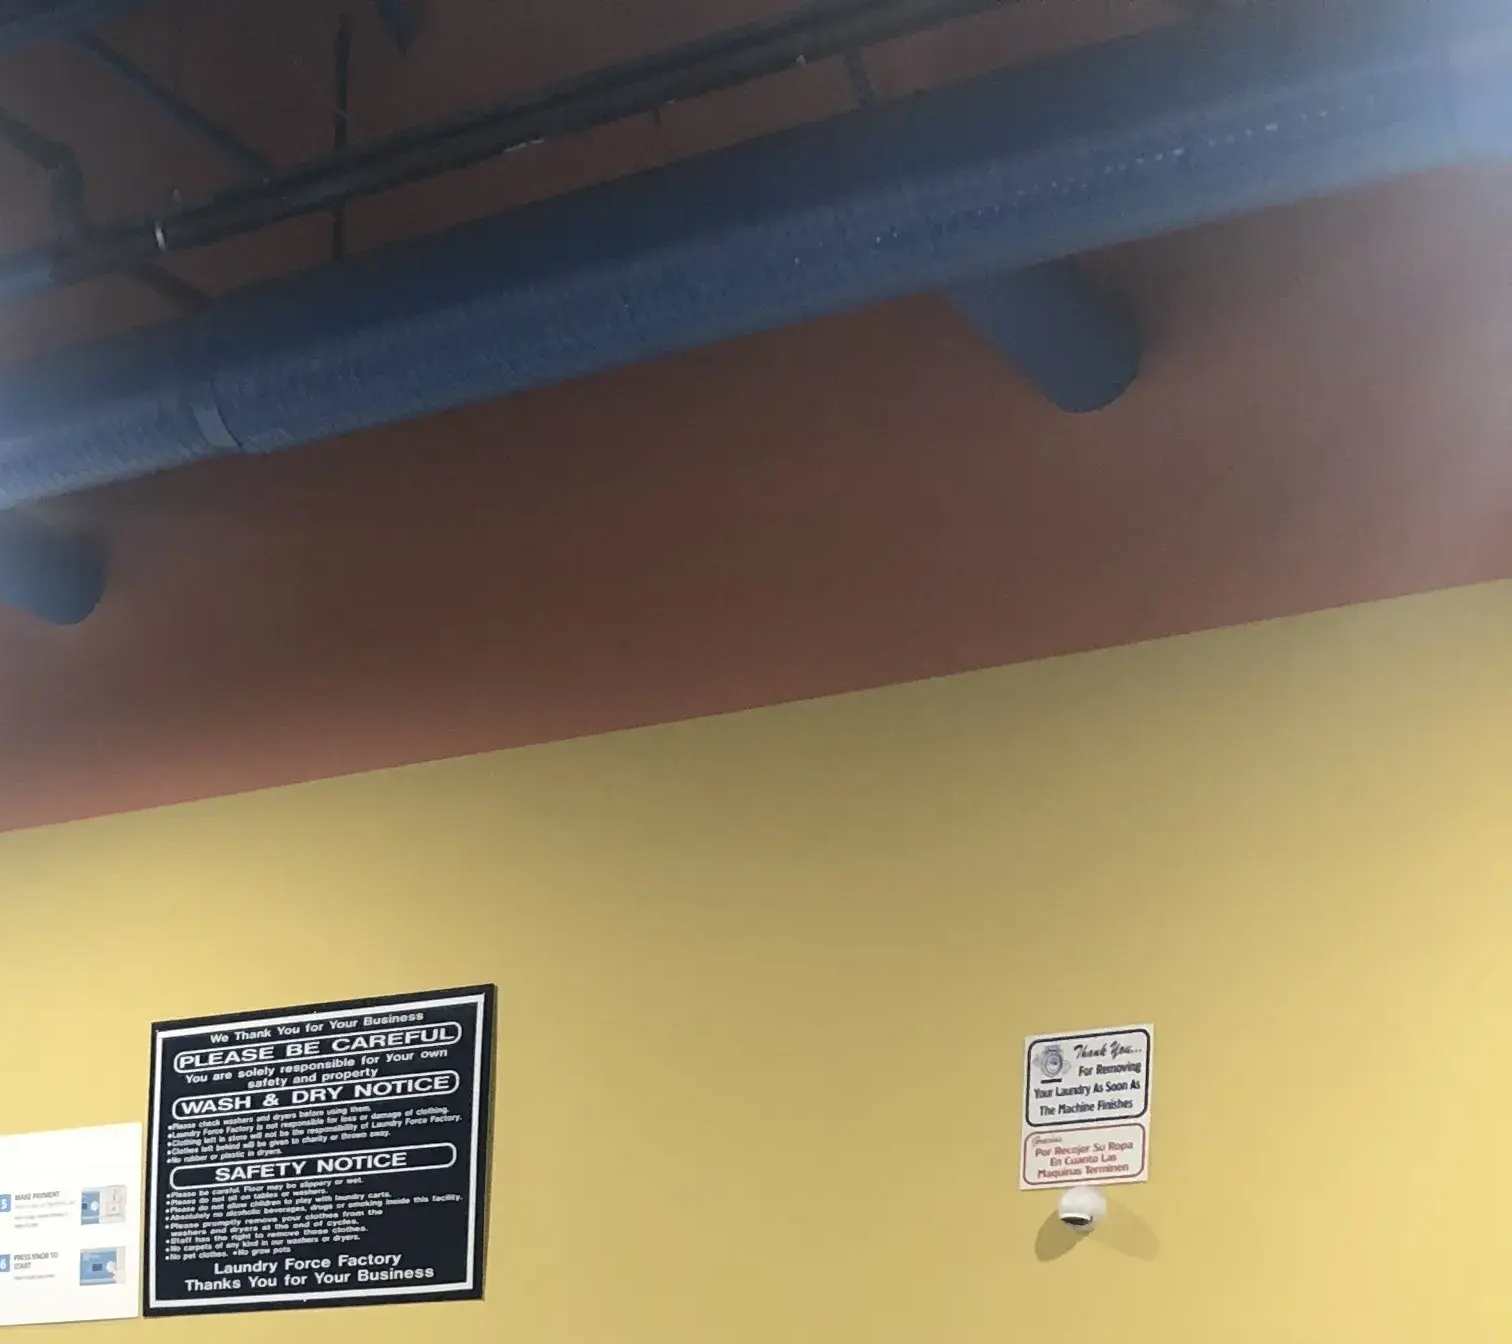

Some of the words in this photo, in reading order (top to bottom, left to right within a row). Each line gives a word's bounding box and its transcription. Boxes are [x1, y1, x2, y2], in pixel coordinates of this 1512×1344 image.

[209, 1033, 229, 1043] We
[233, 1027, 271, 1040] Thank
[276, 1025, 300, 1035] You
[304, 1022, 324, 1032] for
[328, 1019, 358, 1029] Your
[363, 1012, 423, 1026] Business
[179, 1046, 274, 1068] PLEASE
[285, 1040, 320, 1056] BE
[332, 1028, 454, 1051] CAREFUL
[1074, 1042, 1107, 1059] Thank
[185, 1073, 207, 1083] You
[212, 1071, 232, 1080] are
[237, 1065, 275, 1078] solely
[279, 1057, 355, 1073] responsible
[360, 1055, 379, 1065] for
[420, 1049, 447, 1058] own
[1078, 1065, 1094, 1077] For
[1096, 1061, 1141, 1076] Removing
[247, 1076, 288, 1088] safety
[292, 1072, 316, 1083] and
[321, 1067, 378, 1082] property
[181, 1095, 251, 1114] WASH
[262, 1092, 278, 1106] &
[291, 1085, 342, 1103] DRY
[354, 1075, 449, 1097] NOTICE
[1034, 1088, 1054, 1100] Your
[1055, 1084, 1090, 1098] Laundry
[1093, 1082, 1104, 1093] As
[1105, 1080, 1128, 1093] Soon
[1129, 1079, 1141, 1090] As
[1039, 1105, 1055, 1117] The
[1058, 1102, 1095, 1115] Machine
[1097, 1099, 1133, 1112] Finishes
[1093, 1142, 1106, 1152] Su
[1108, 1141, 1133, 1153] Ropa
[214, 1160, 306, 1181] SAFETY
[316, 1151, 407, 1172] NOTICE
[1050, 1156, 1062, 1166] En
[1101, 1152, 1117, 1163] Las
[214, 1260, 278, 1274] Laundry
[284, 1257, 331, 1270] Force
[337, 1253, 401, 1266] Factory
[184, 1277, 241, 1291] Thanks
[247, 1275, 277, 1287] You
[283, 1273, 307, 1286] for
[313, 1271, 350, 1284] Your
[357, 1267, 434, 1281] Business
